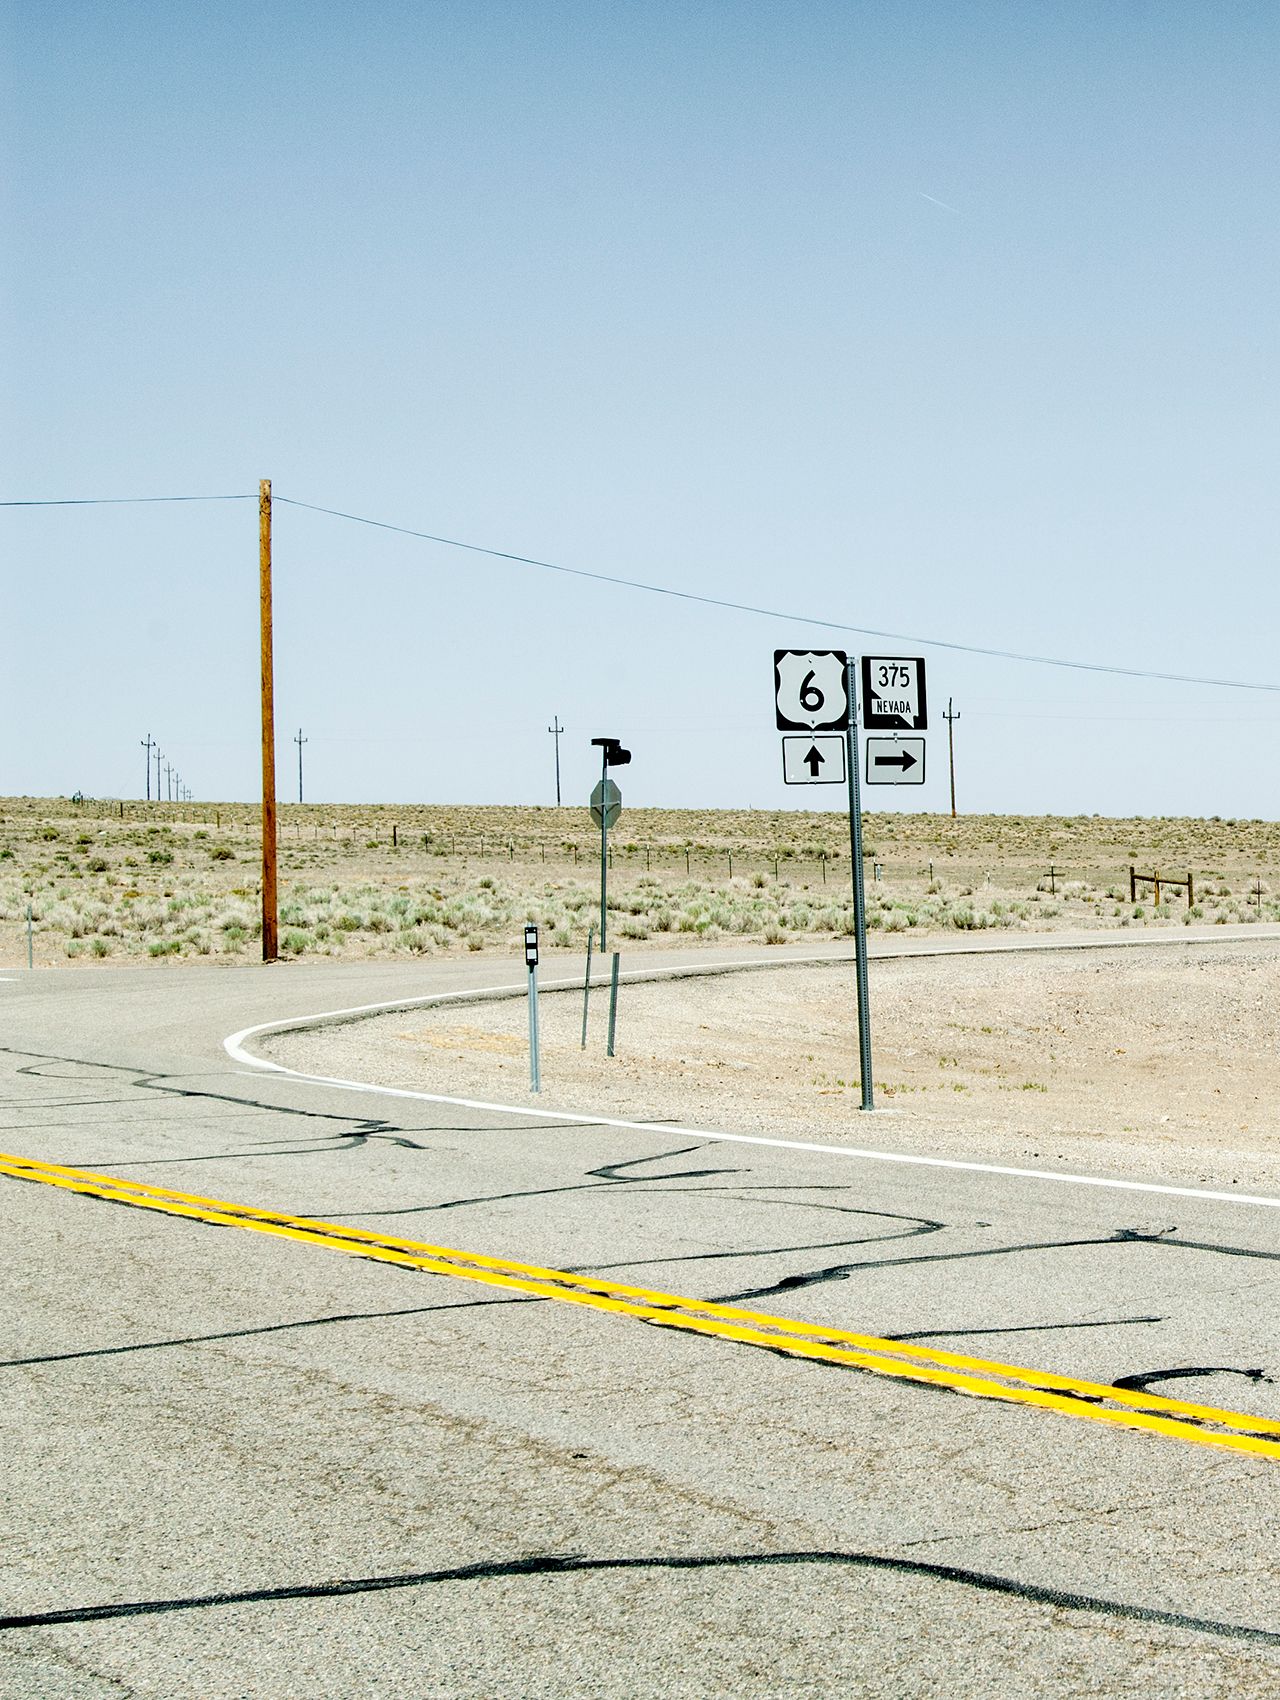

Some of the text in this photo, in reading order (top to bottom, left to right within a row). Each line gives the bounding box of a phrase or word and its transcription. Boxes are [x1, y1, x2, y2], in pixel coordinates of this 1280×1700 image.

[878, 666, 910, 687] 375
[800, 670, 825, 712] 6
[877, 701, 911, 713] NEVADA
